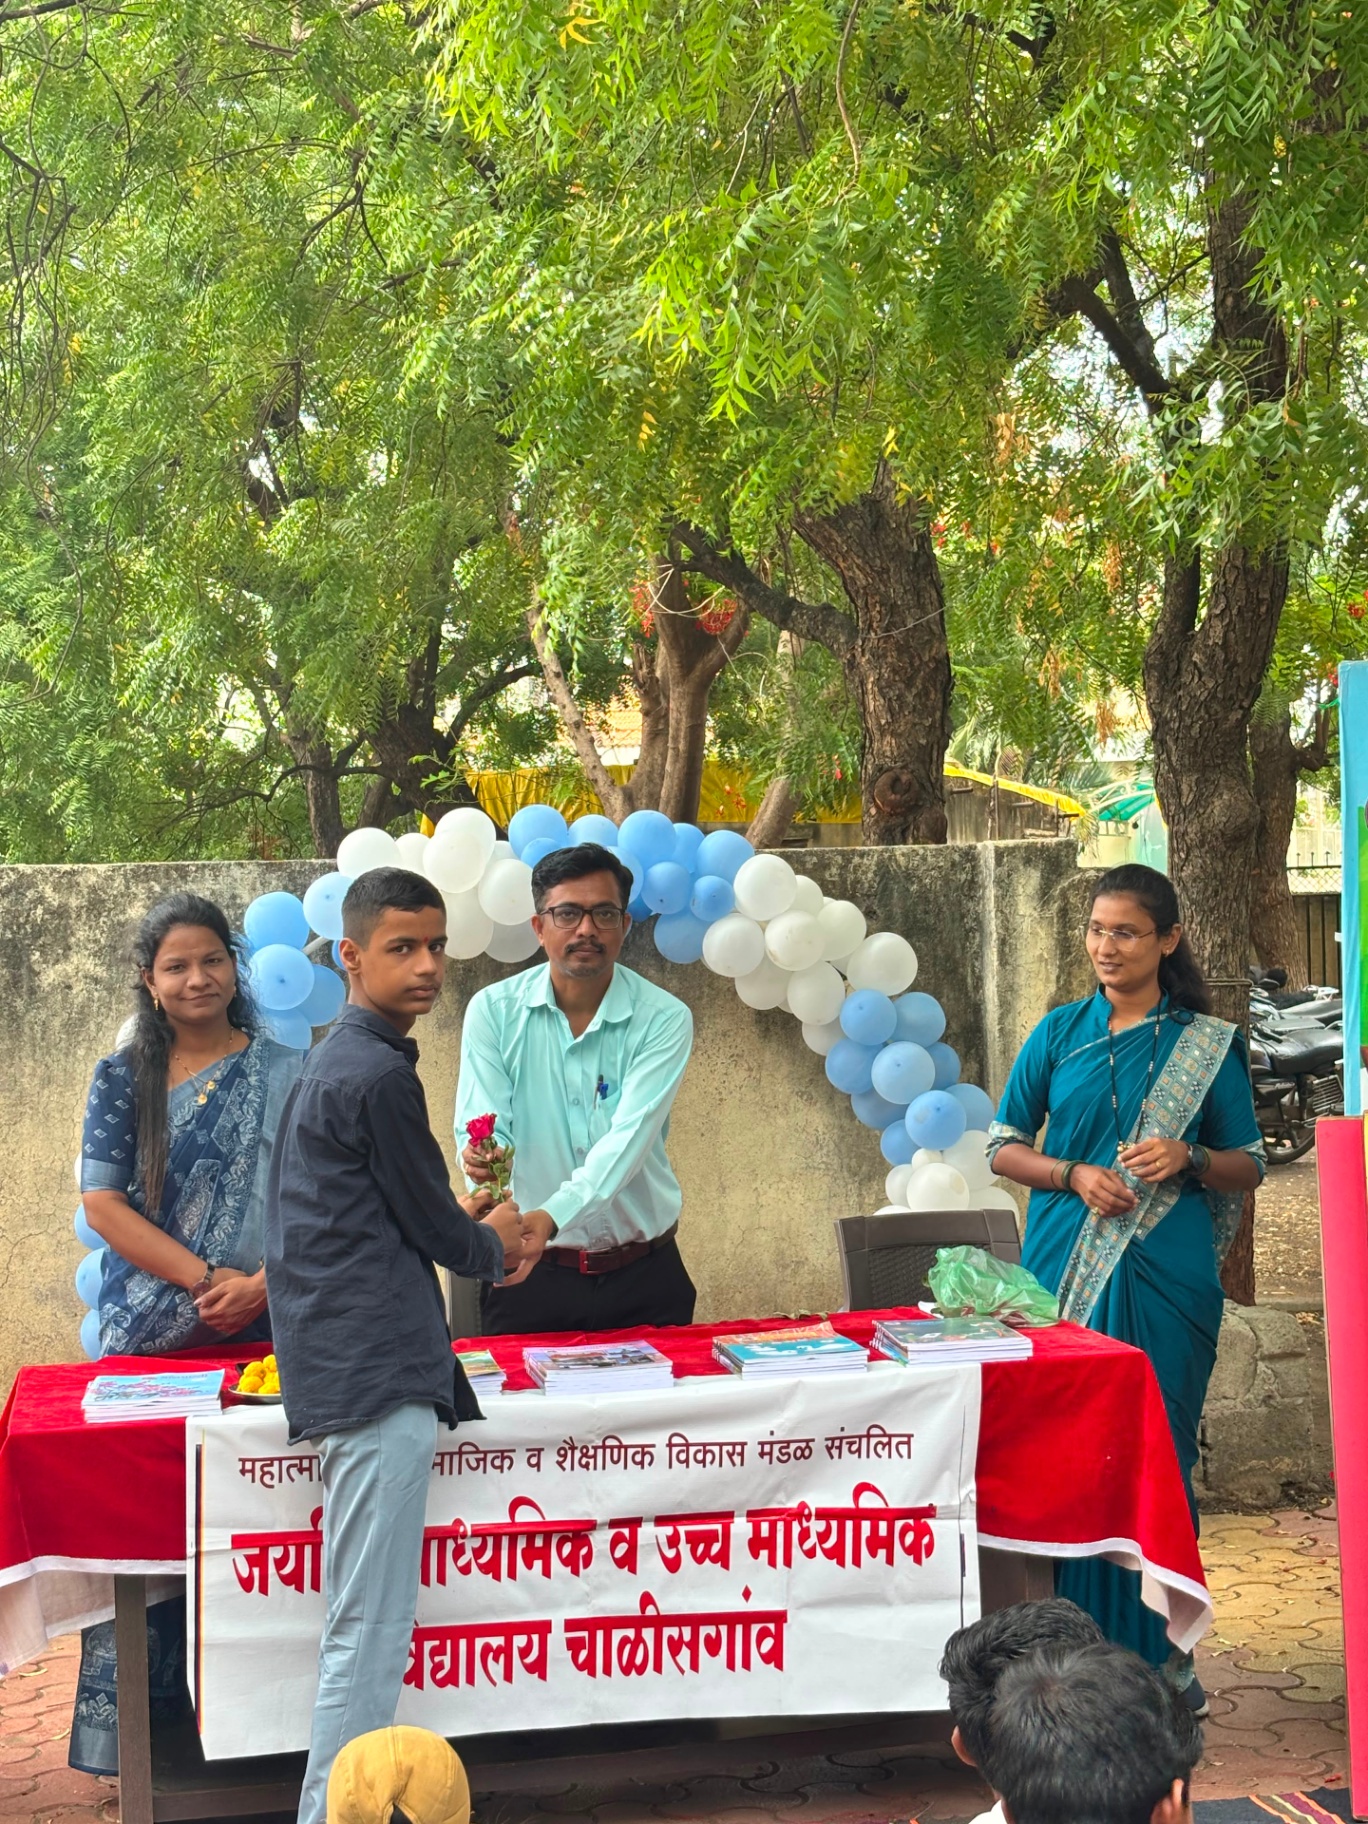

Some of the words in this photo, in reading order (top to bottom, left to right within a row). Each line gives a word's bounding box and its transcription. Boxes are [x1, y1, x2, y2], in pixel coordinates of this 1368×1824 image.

[432, 1440, 517, 1476] माजिक
[525, 1447, 545, 1472] व
[555, 1434, 656, 1472] शैक्षणिक
[665, 1432, 748, 1470] विकास
[757, 1429, 816, 1466] मंडळ
[824, 1423, 914, 1460] संचलित
[608, 1516, 643, 1575] व
[654, 1510, 736, 1575] उच्च
[745, 1481, 938, 1569] माध्यमिक
[563, 1585, 789, 1679] चाळीसगांव
